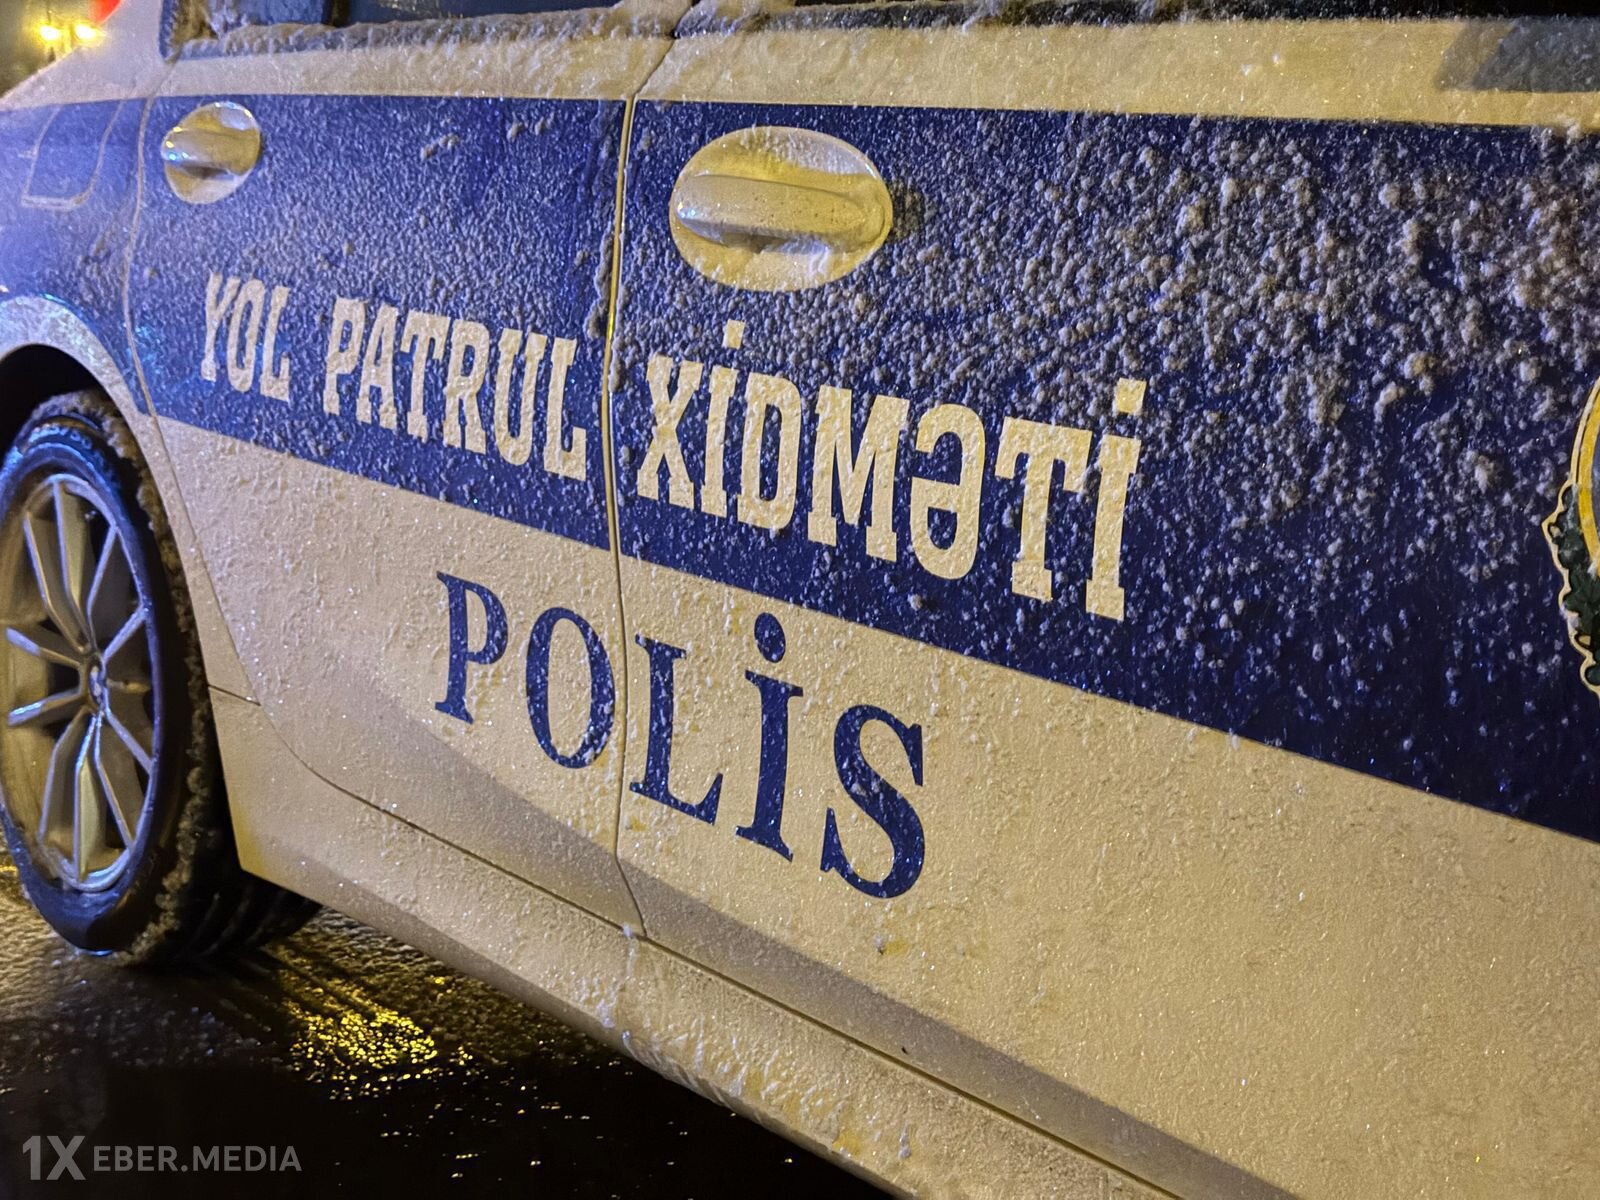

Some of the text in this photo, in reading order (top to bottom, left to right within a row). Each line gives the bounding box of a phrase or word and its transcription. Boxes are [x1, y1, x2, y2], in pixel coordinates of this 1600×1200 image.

[200, 272, 1147, 620] YOL PATRUL XİDMƏTİ
[435, 571, 925, 899] POLİS
